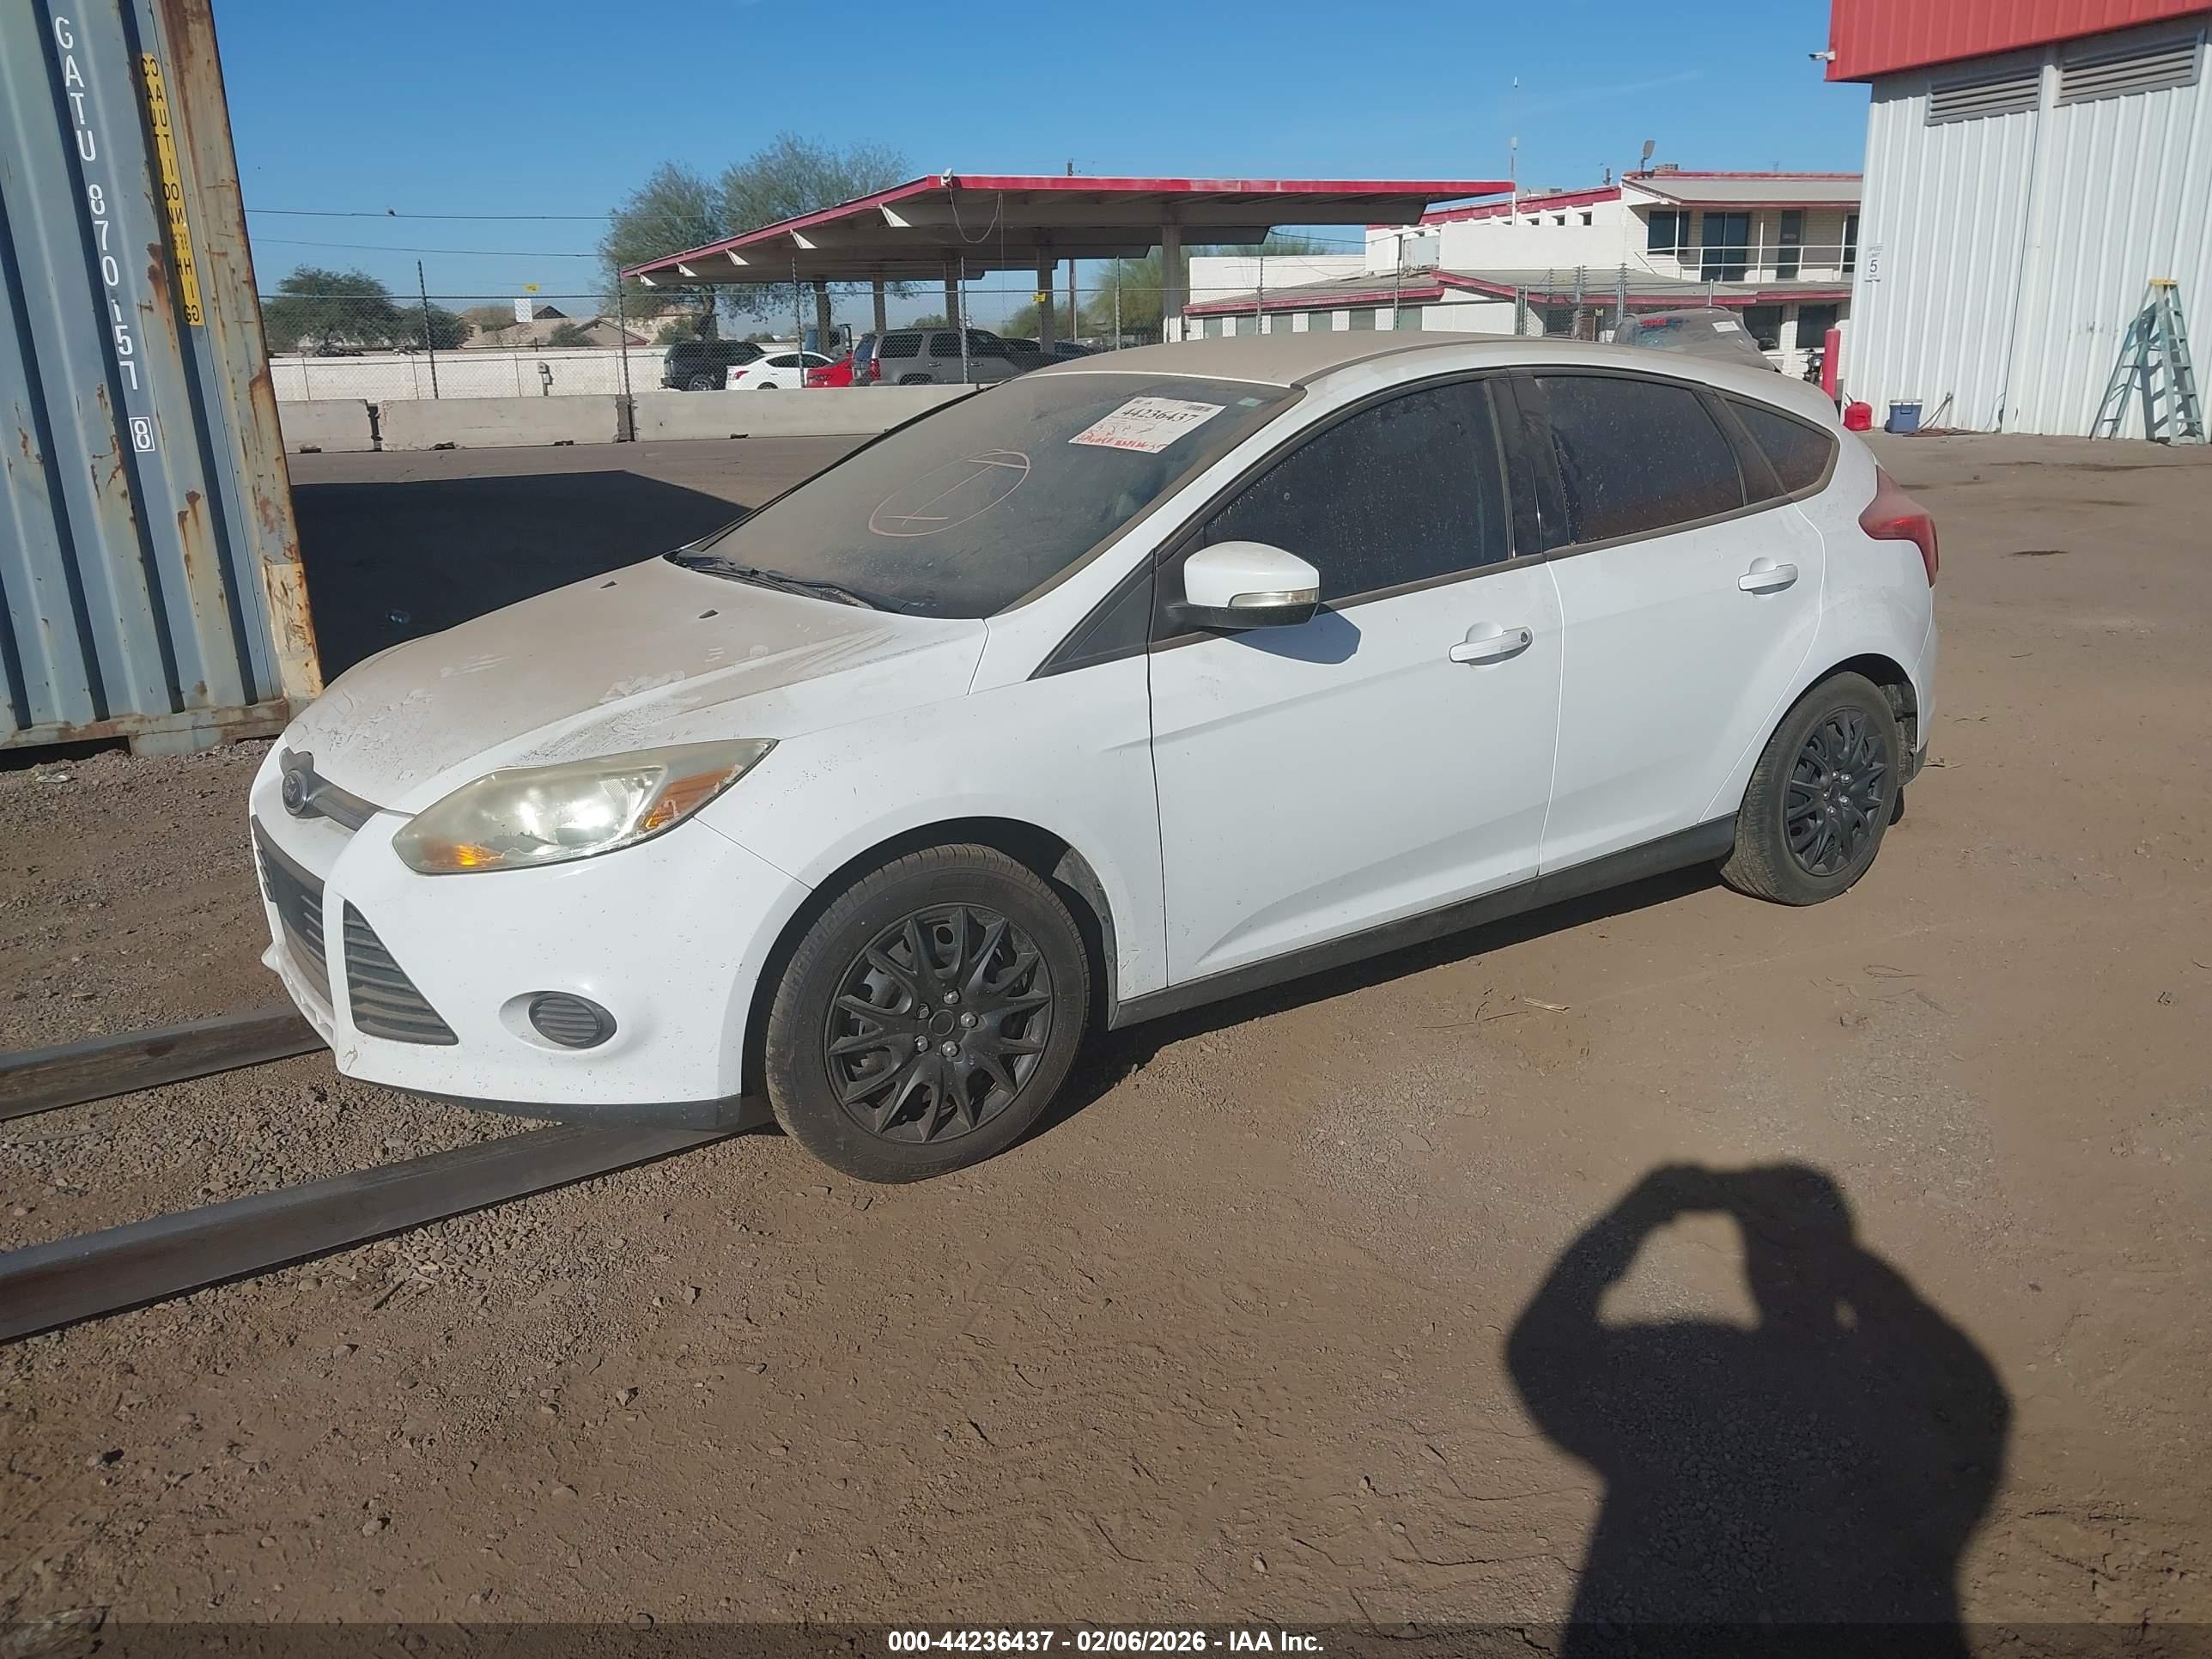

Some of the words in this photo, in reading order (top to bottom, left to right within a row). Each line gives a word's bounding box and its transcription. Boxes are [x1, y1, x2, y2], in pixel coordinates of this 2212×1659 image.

[55, 16, 96, 161] GATU
[133, 420, 149, 450] 8
[1869, 259, 1878, 273] 5
[1121, 407, 1200, 423] 44236437
